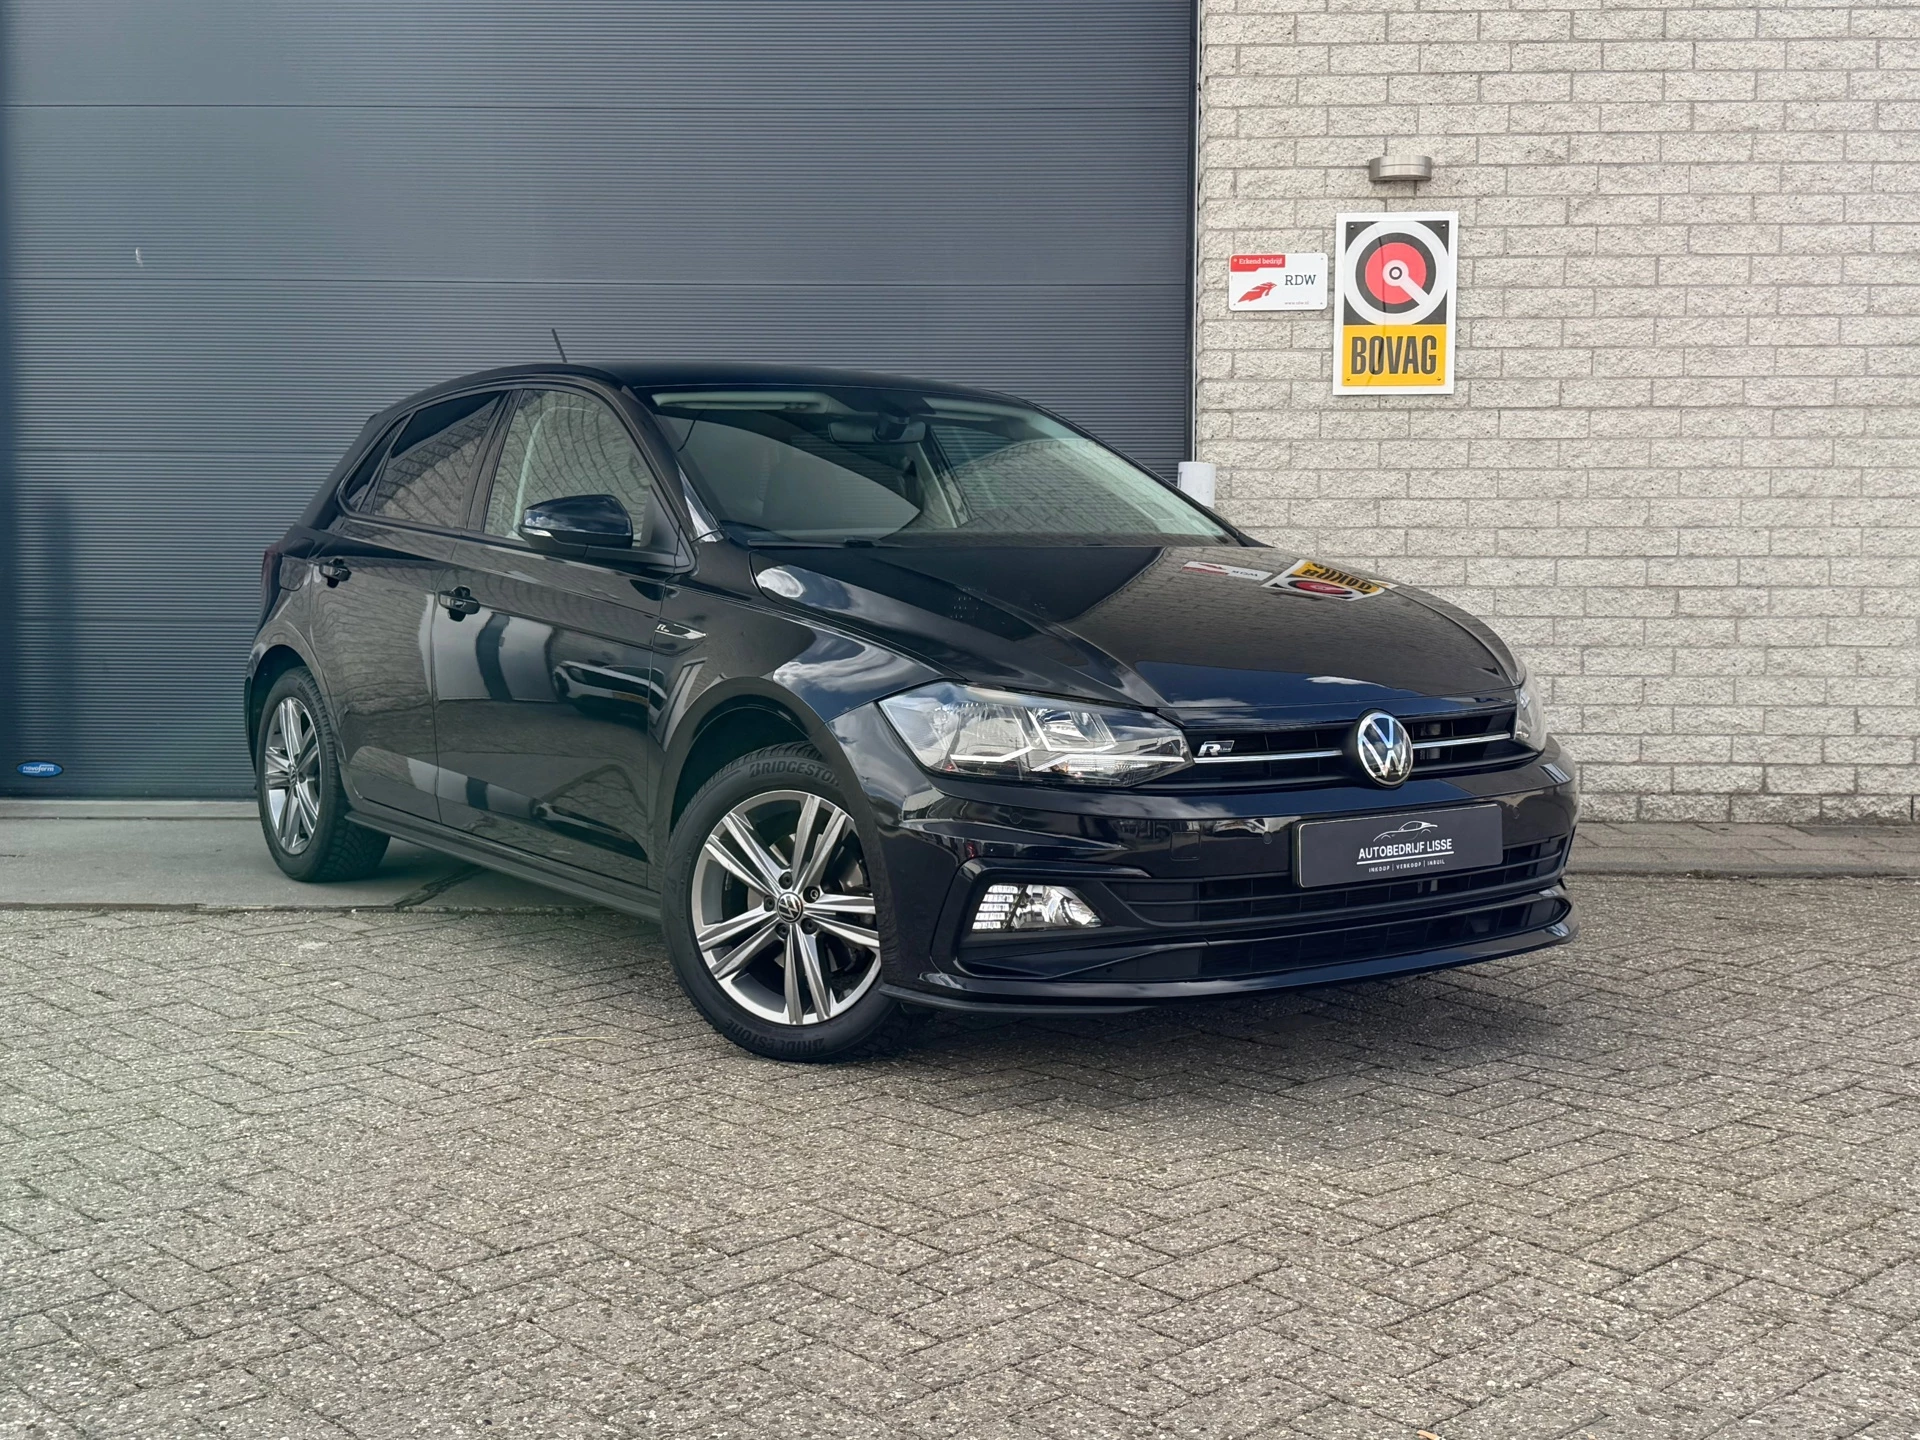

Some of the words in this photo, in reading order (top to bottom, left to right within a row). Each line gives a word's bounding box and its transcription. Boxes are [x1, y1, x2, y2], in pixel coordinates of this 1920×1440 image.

[1262, 258, 1283, 266] bedrijf
[1284, 274, 1317, 286] RDW
[1351, 335, 1437, 375] BOVAG
[22, 764, 55, 774] novoferm
[1358, 841, 1425, 859] AUTOBEDRIJF
[1426, 838, 1452, 852] LISSE
[1368, 865, 1390, 873] INKOOP
[1396, 861, 1422, 870] VERKOOP
